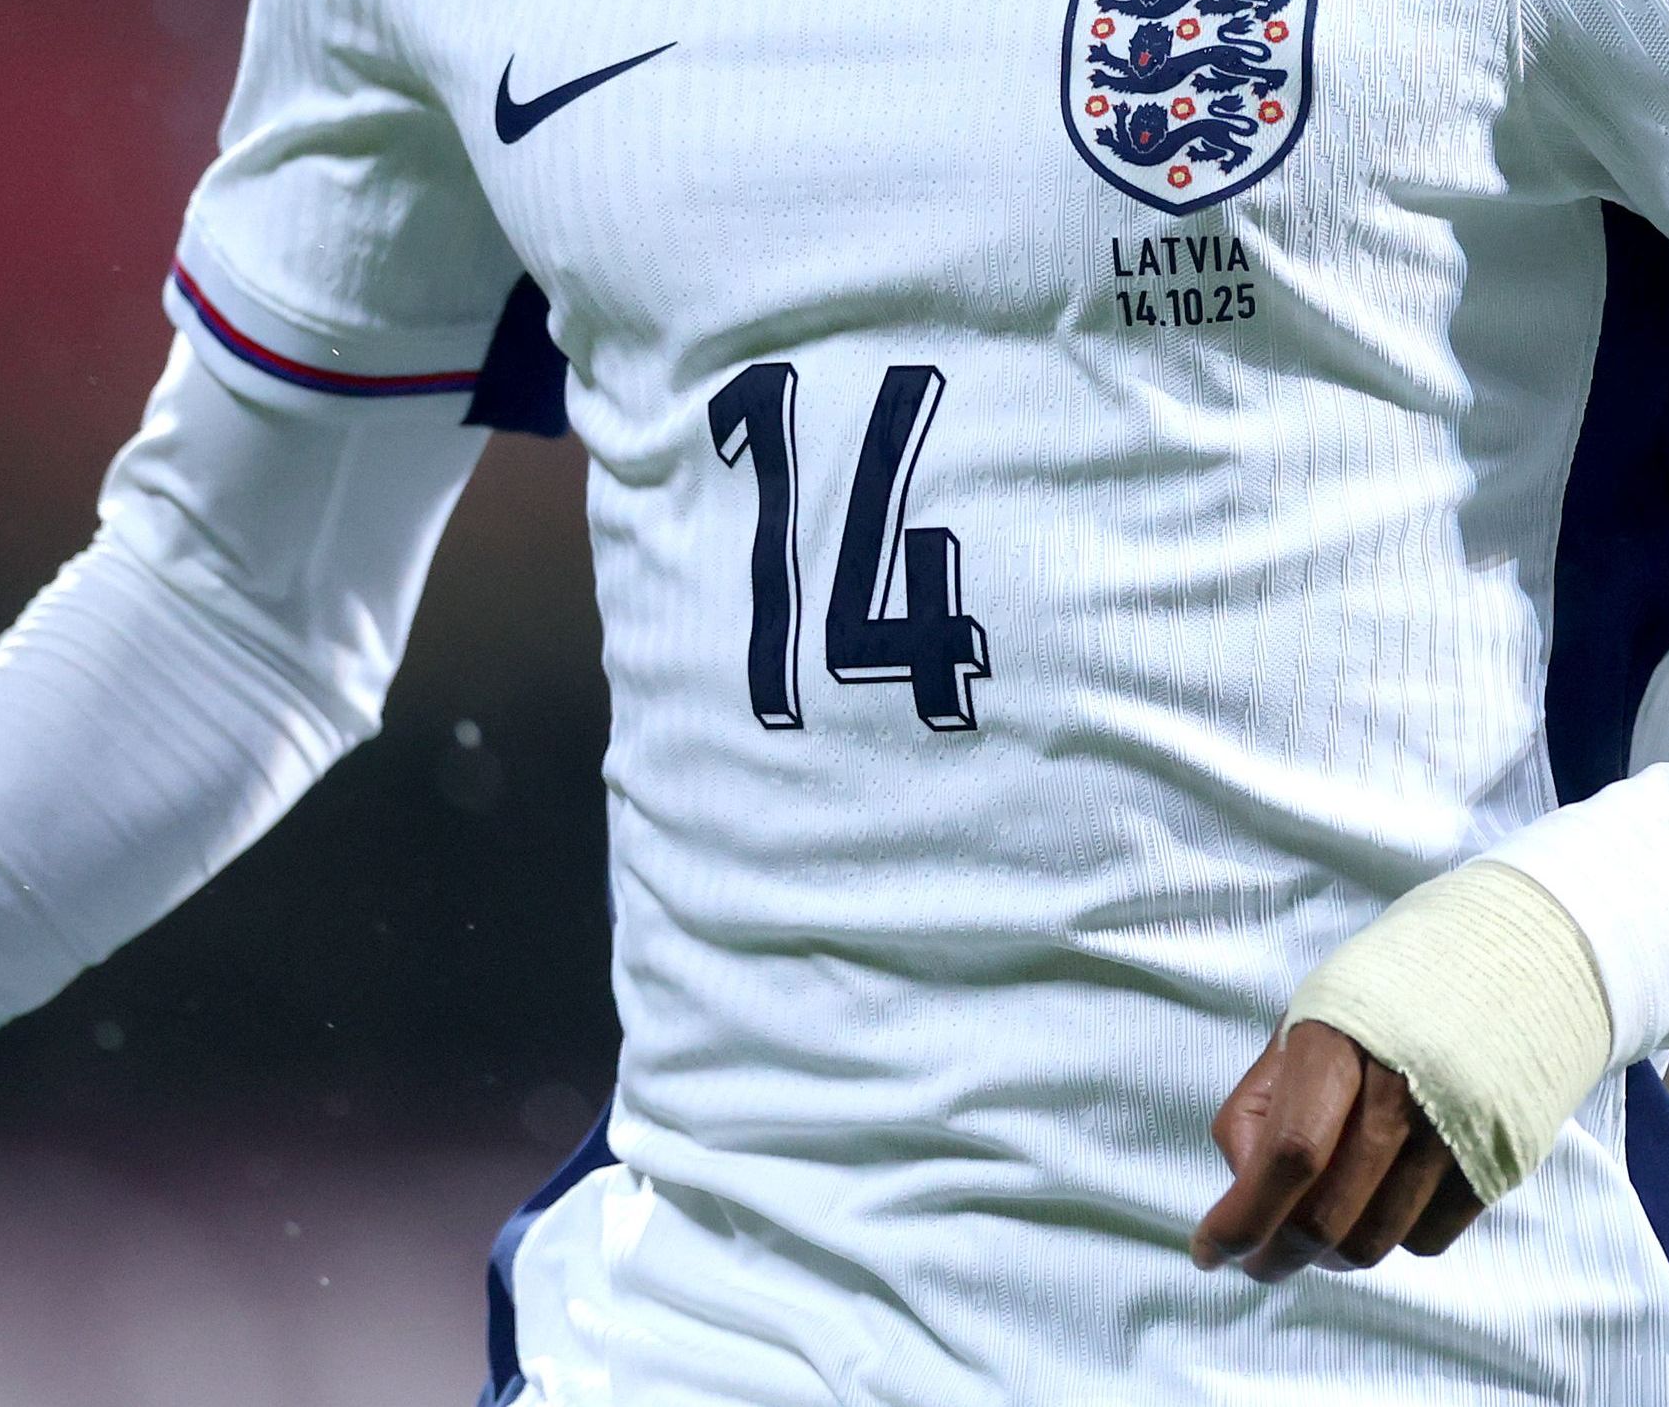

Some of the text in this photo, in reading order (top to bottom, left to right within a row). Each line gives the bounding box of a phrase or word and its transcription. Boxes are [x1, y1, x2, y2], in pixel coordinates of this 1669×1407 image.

[1111, 236, 1250, 278] LATVIA
[1116, 283, 1257, 328] 14.10.25
[708, 362, 992, 732] 14
